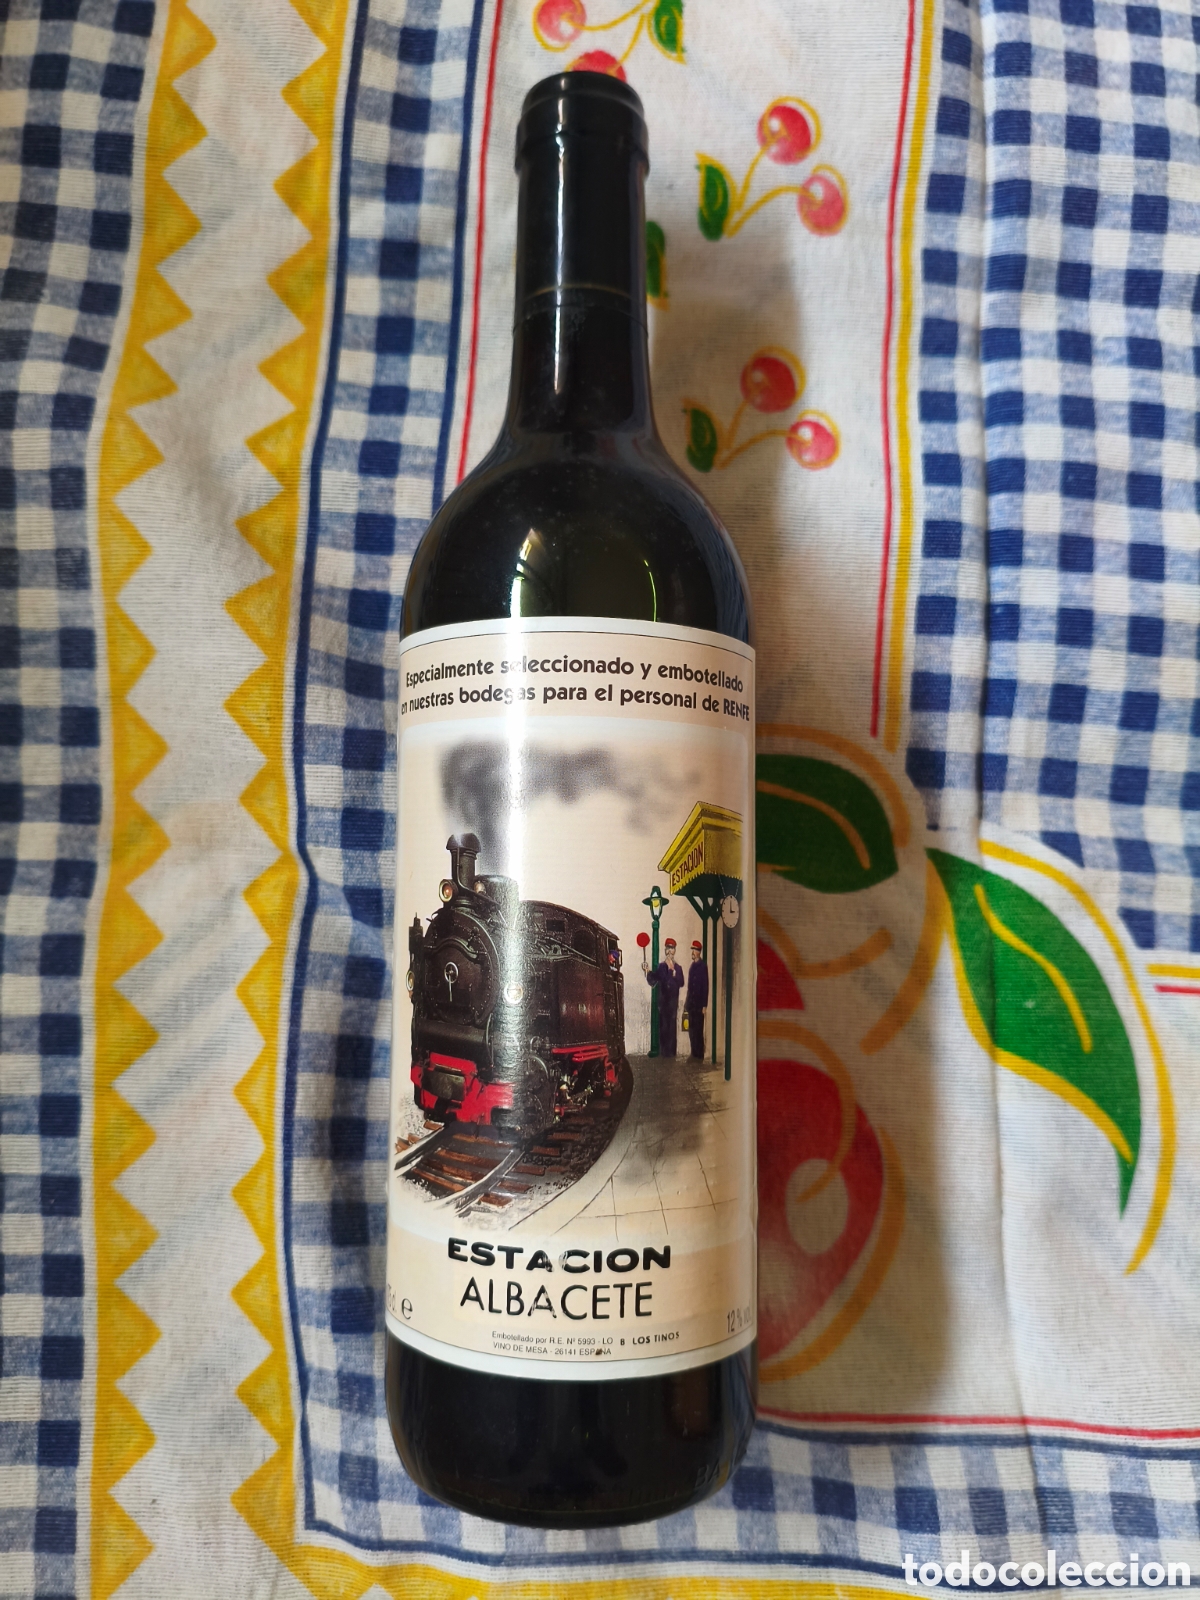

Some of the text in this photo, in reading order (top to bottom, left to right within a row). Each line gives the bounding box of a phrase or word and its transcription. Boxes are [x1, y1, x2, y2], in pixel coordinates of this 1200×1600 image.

[406, 655, 744, 693] Especialmente seleccionado y embotellado
[401, 684, 750, 722] en nuestras bodegas para el personal de RENFE
[671, 841, 704, 887] ESTACION
[447, 1236, 671, 1274] ESTACION
[459, 1276, 653, 1321] ALBACETE
[492, 1330, 533, 1343] Embotellado
[535, 1335, 547, 1345] por
[577, 1337, 596, 1345] 5993
[602, 1336, 614, 1345] LO
[632, 1335, 651, 1345] LOS
[654, 1331, 680, 1342] TINOS
[493, 1341, 511, 1351] VINO
[512, 1344, 524, 1353] DE
[525, 1345, 548, 1355] MESA
